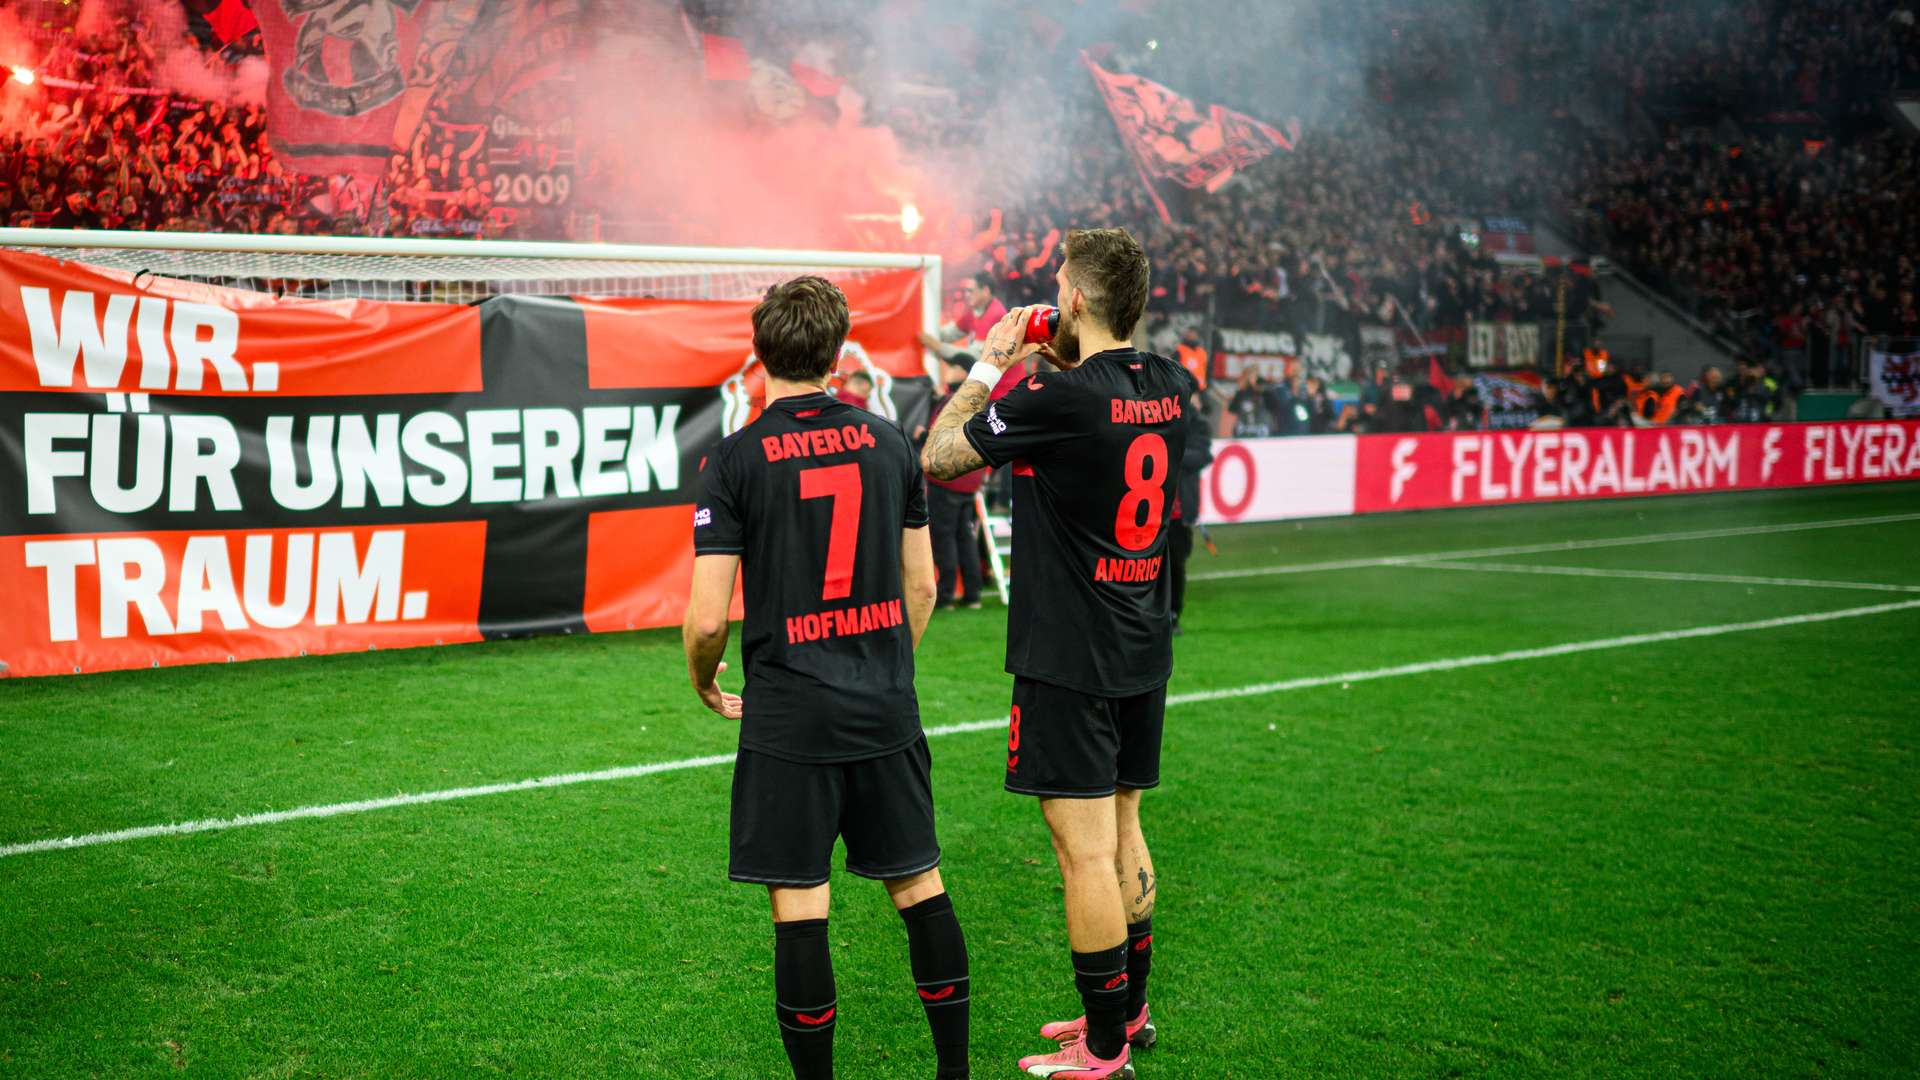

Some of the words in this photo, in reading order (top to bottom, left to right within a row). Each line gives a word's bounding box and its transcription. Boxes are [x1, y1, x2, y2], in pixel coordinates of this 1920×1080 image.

[494, 173, 569, 204] 2009
[20, 286, 279, 391] WIR.
[25, 393, 242, 513] FÜR
[266, 406, 681, 509] UNSEREN
[1114, 433, 1169, 551] 8
[1452, 430, 1740, 501] FLYERALARM
[800, 462, 863, 600] 7
[26, 531, 428, 641] TRAUM.
[786, 599, 904, 645] HOFMANN
[1008, 704, 1021, 752] 8
